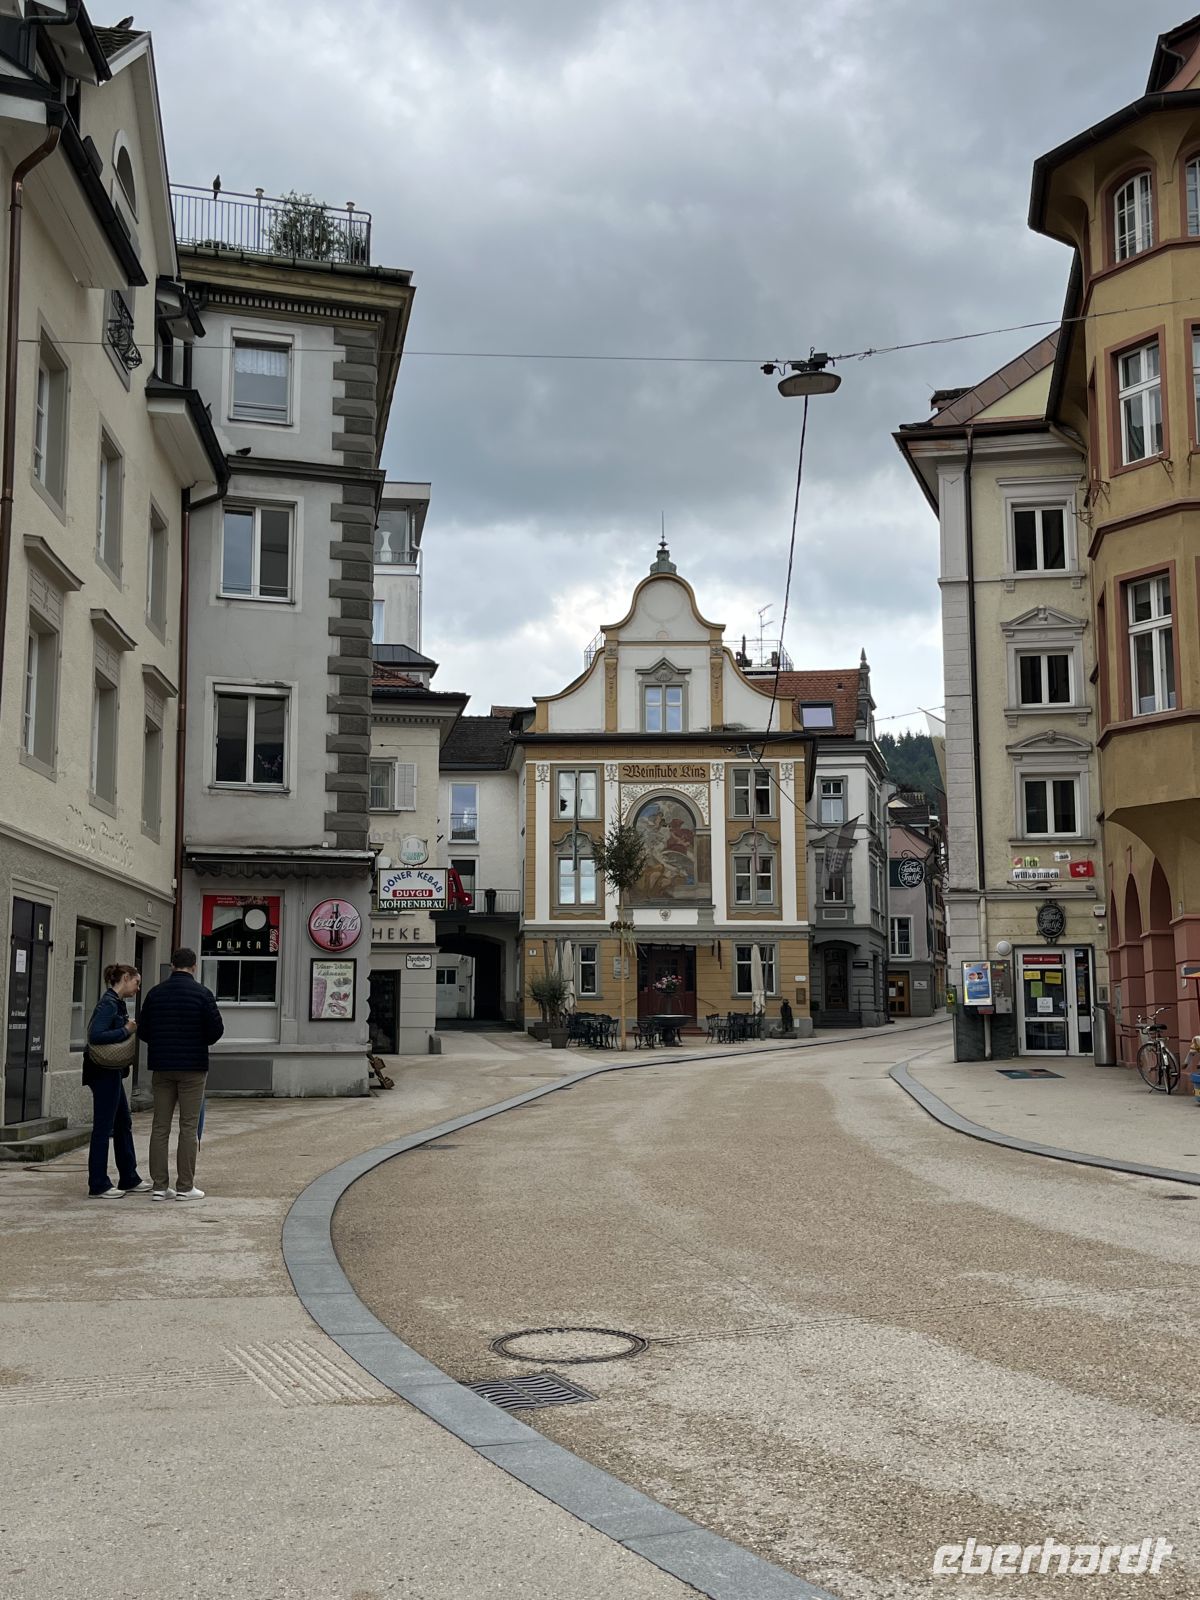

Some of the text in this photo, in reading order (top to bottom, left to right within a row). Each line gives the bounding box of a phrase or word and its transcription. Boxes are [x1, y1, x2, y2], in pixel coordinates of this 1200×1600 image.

[680, 764, 706, 779] Kinz
[382, 870, 443, 893] DÖNER KEBAB
[380, 899, 446, 909] MOHRENBRÄU
[372, 927, 420, 940] HEKE
[216, 938, 262, 949] DÖNER
